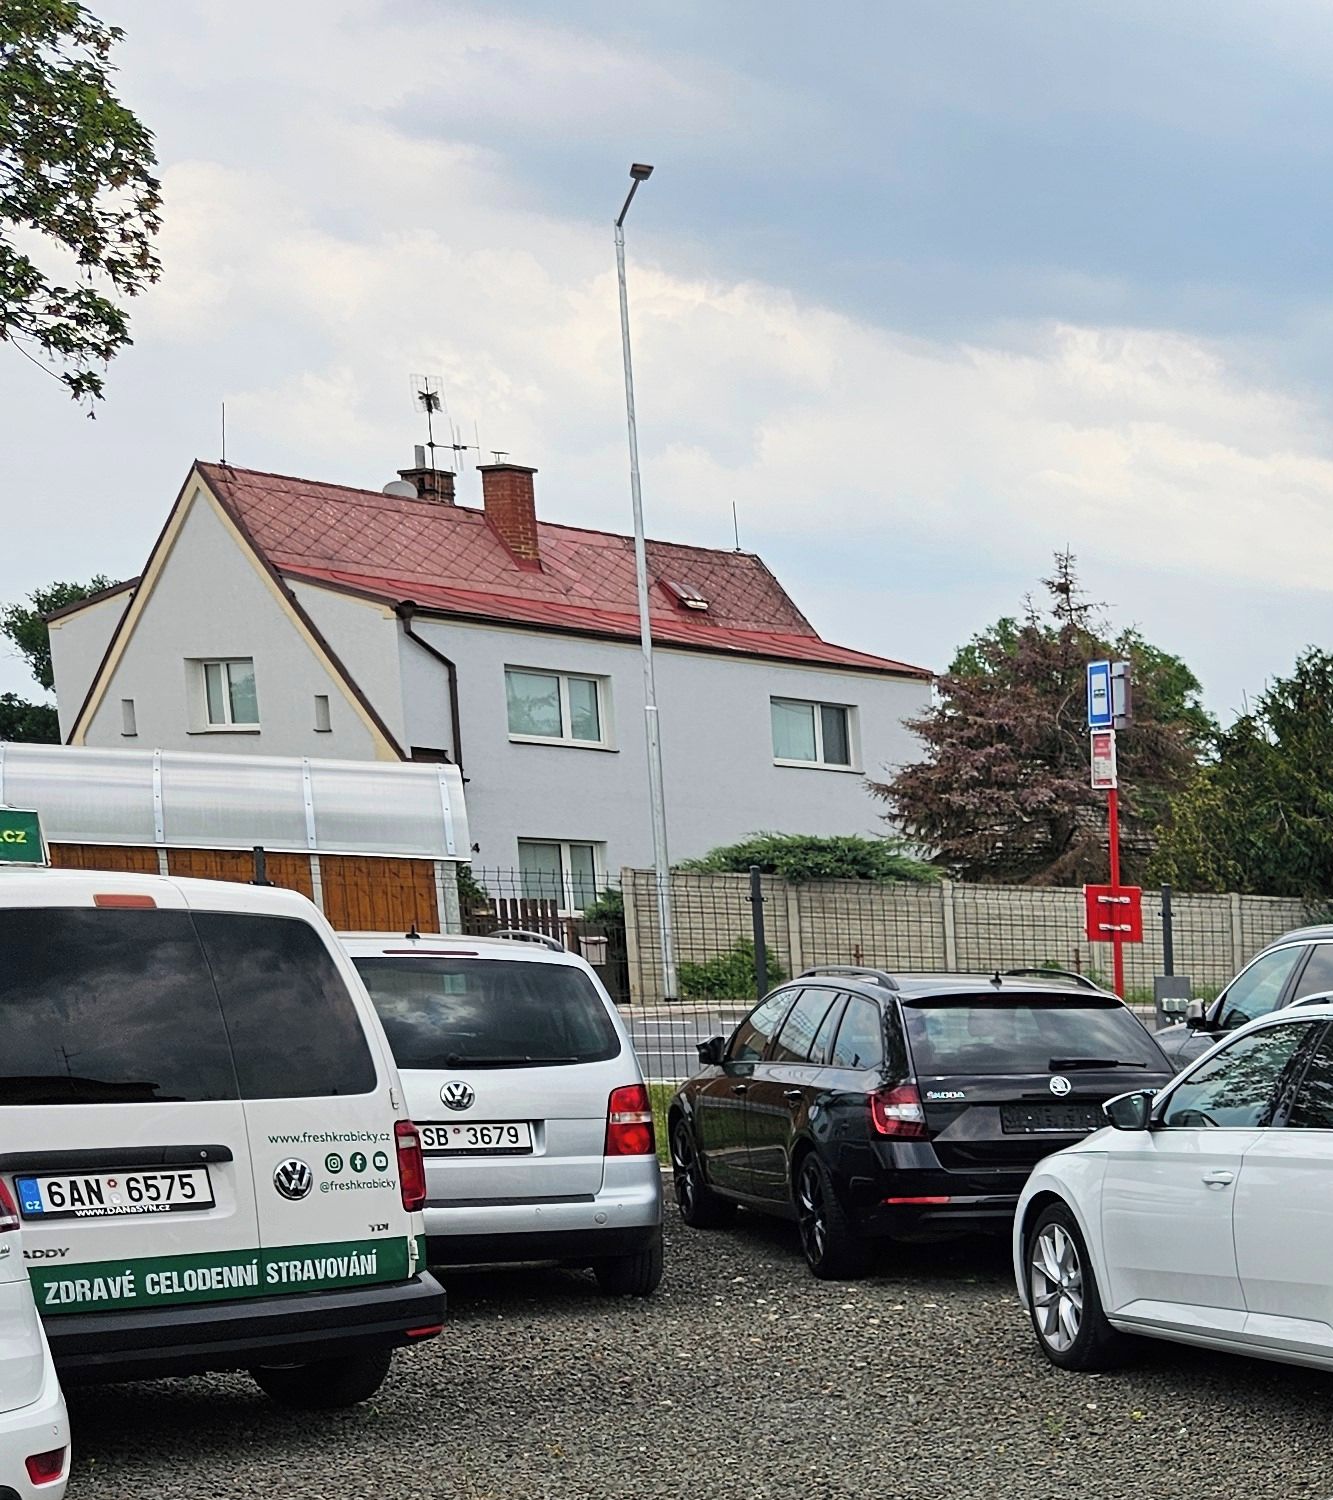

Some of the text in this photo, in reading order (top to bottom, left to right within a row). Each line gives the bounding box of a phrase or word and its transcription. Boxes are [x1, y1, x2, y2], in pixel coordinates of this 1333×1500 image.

[268, 1131, 391, 1144] www.freshkrabicky.cz
[422, 1126, 519, 1146] SB 3679
[25, 1173, 196, 1210] CZ 6AN 6575
[320, 1178, 396, 1193] @freshkrabicky
[23, 1247, 70, 1259] ADDY
[43, 1248, 377, 1305] ZDRAVÉ CELODENNÍ STRAVOVÁNÍ
